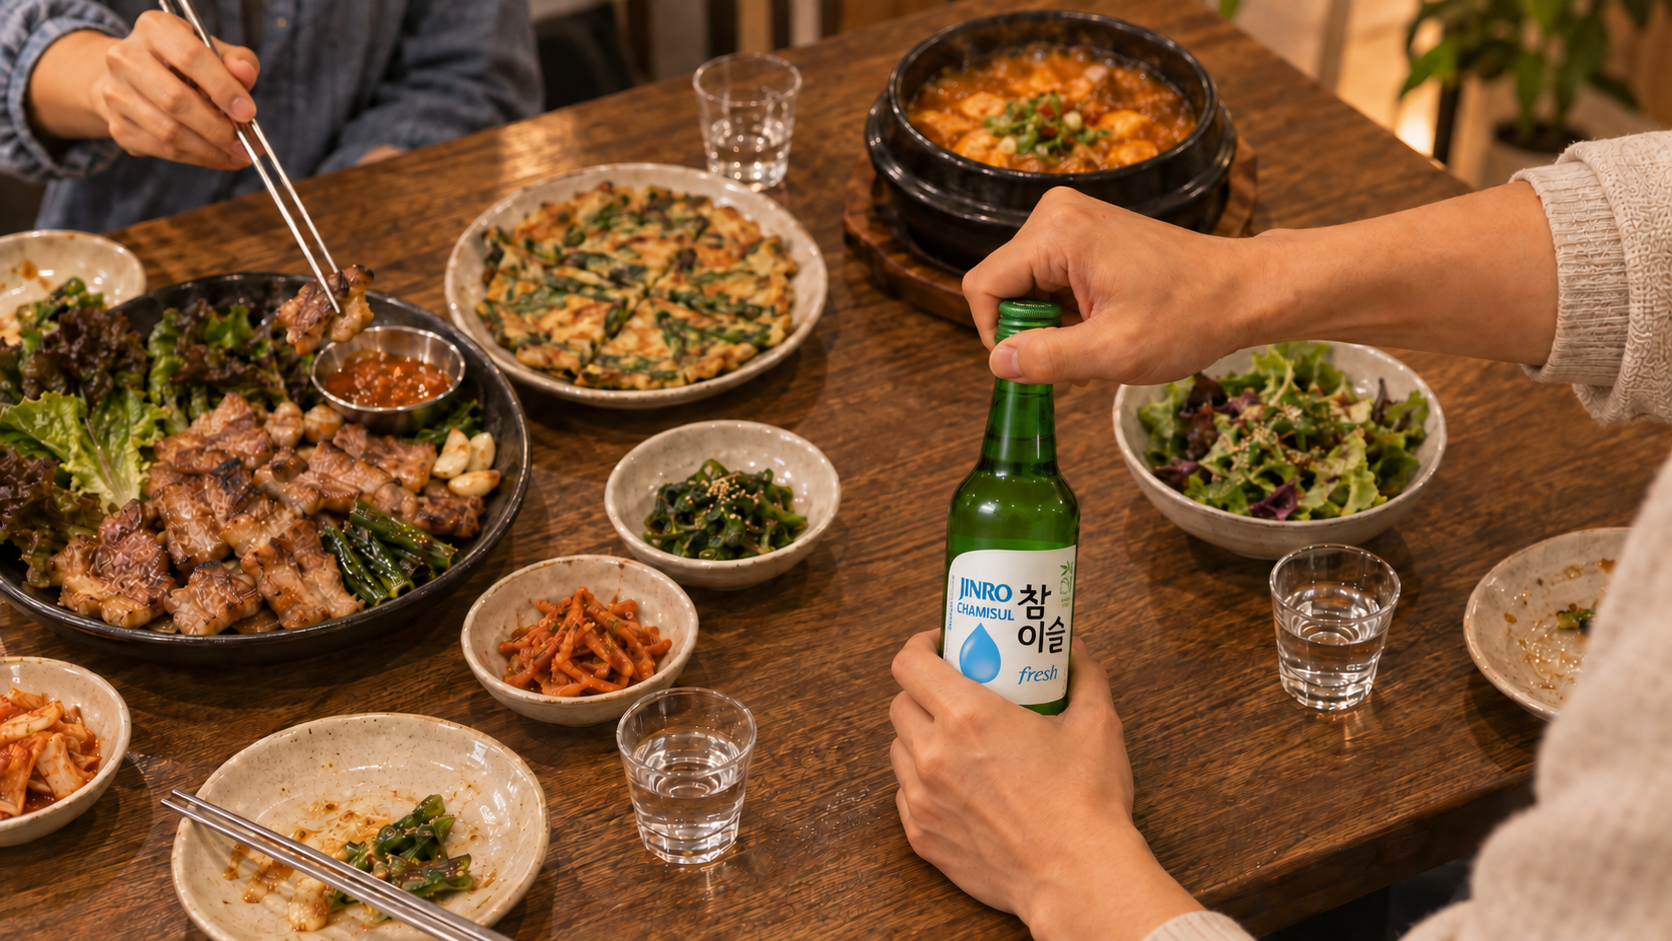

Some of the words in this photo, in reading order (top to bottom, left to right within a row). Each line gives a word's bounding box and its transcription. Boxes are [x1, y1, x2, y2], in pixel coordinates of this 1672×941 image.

[958, 577, 1013, 602] JINRO
[1017, 584, 1052, 620] 참
[957, 602, 1015, 621] CHAMISUL
[1017, 616, 1066, 654] 이슬
[1018, 664, 1058, 685] fresh
